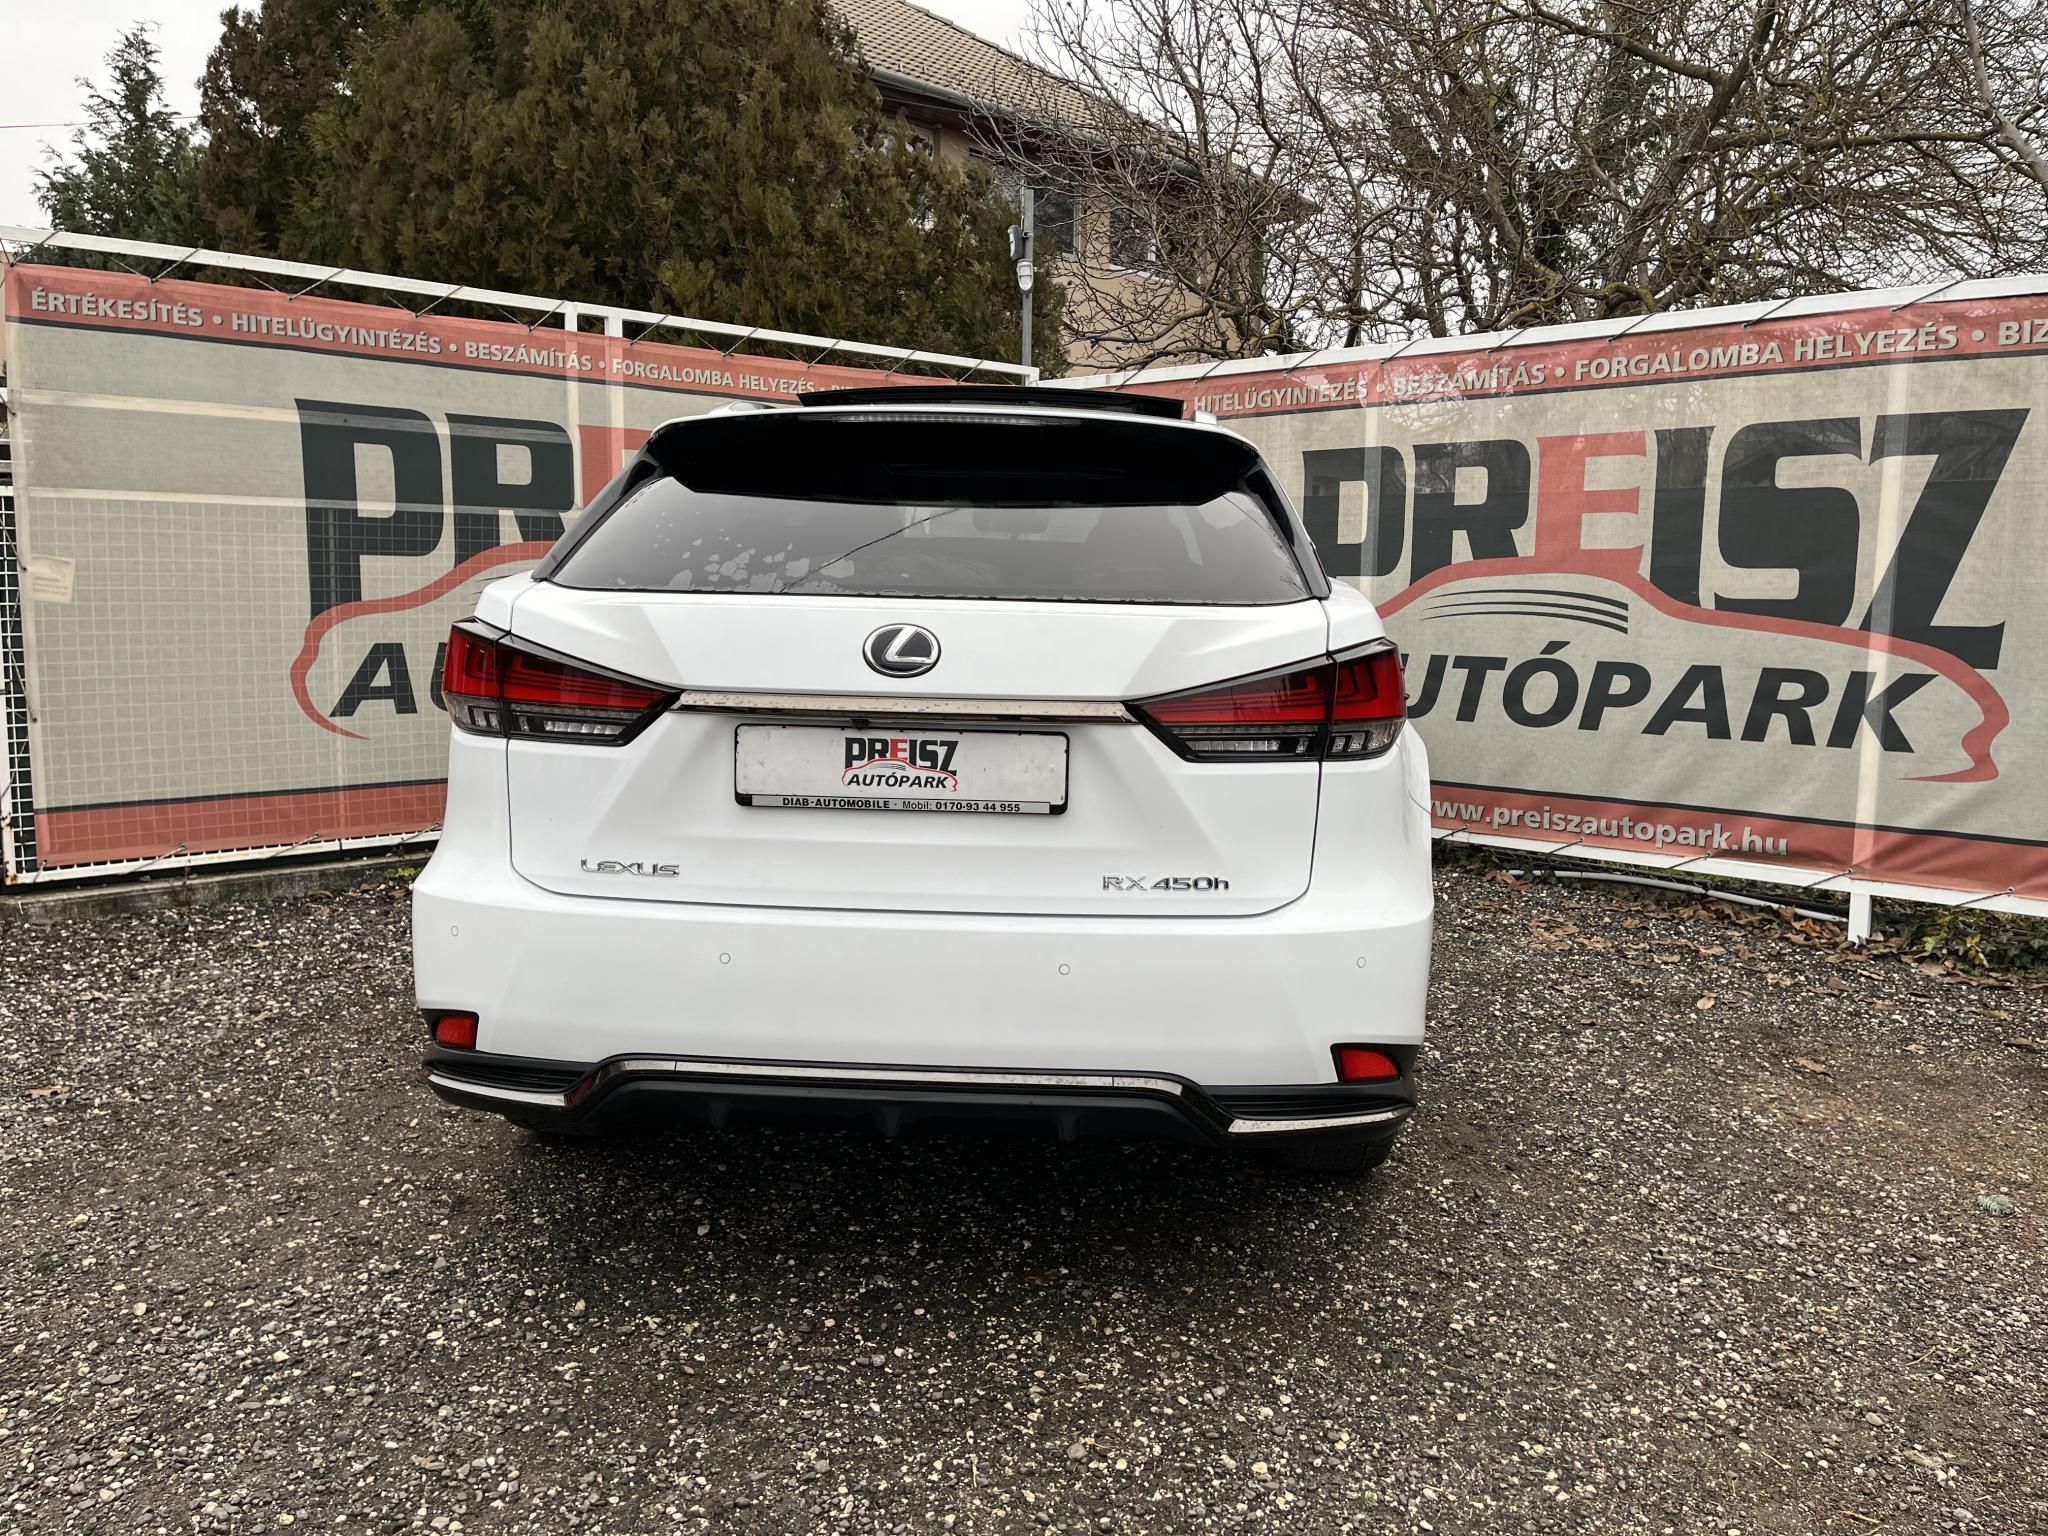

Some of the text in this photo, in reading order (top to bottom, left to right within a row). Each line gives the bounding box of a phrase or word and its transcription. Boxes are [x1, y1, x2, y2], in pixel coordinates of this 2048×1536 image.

[31, 287, 816, 395] ÉRTÉKESÍTÉS HITELÜGYINTÉZÉS BESZÁMÍTÁS FORGALOMBA HELYEZÉS
[1392, 360, 1546, 397] BESZÁMÍTÁS
[1575, 342, 1785, 382] FORGALOMBA
[1794, 321, 1959, 363] HELYEZÉS
[1302, 407, 2031, 671] PREISZ
[844, 737, 959, 776] PREISZ
[846, 772, 949, 790] AUTÓPARK
[782, 797, 1021, 813] DIAB-AUTOMOBILE Mobil: 0170-93 44 955
[1431, 799, 1789, 857] ww.preiszautopark.hu
[580, 858, 680, 878] LEXUS
[1102, 875, 1230, 891] RX 450h
